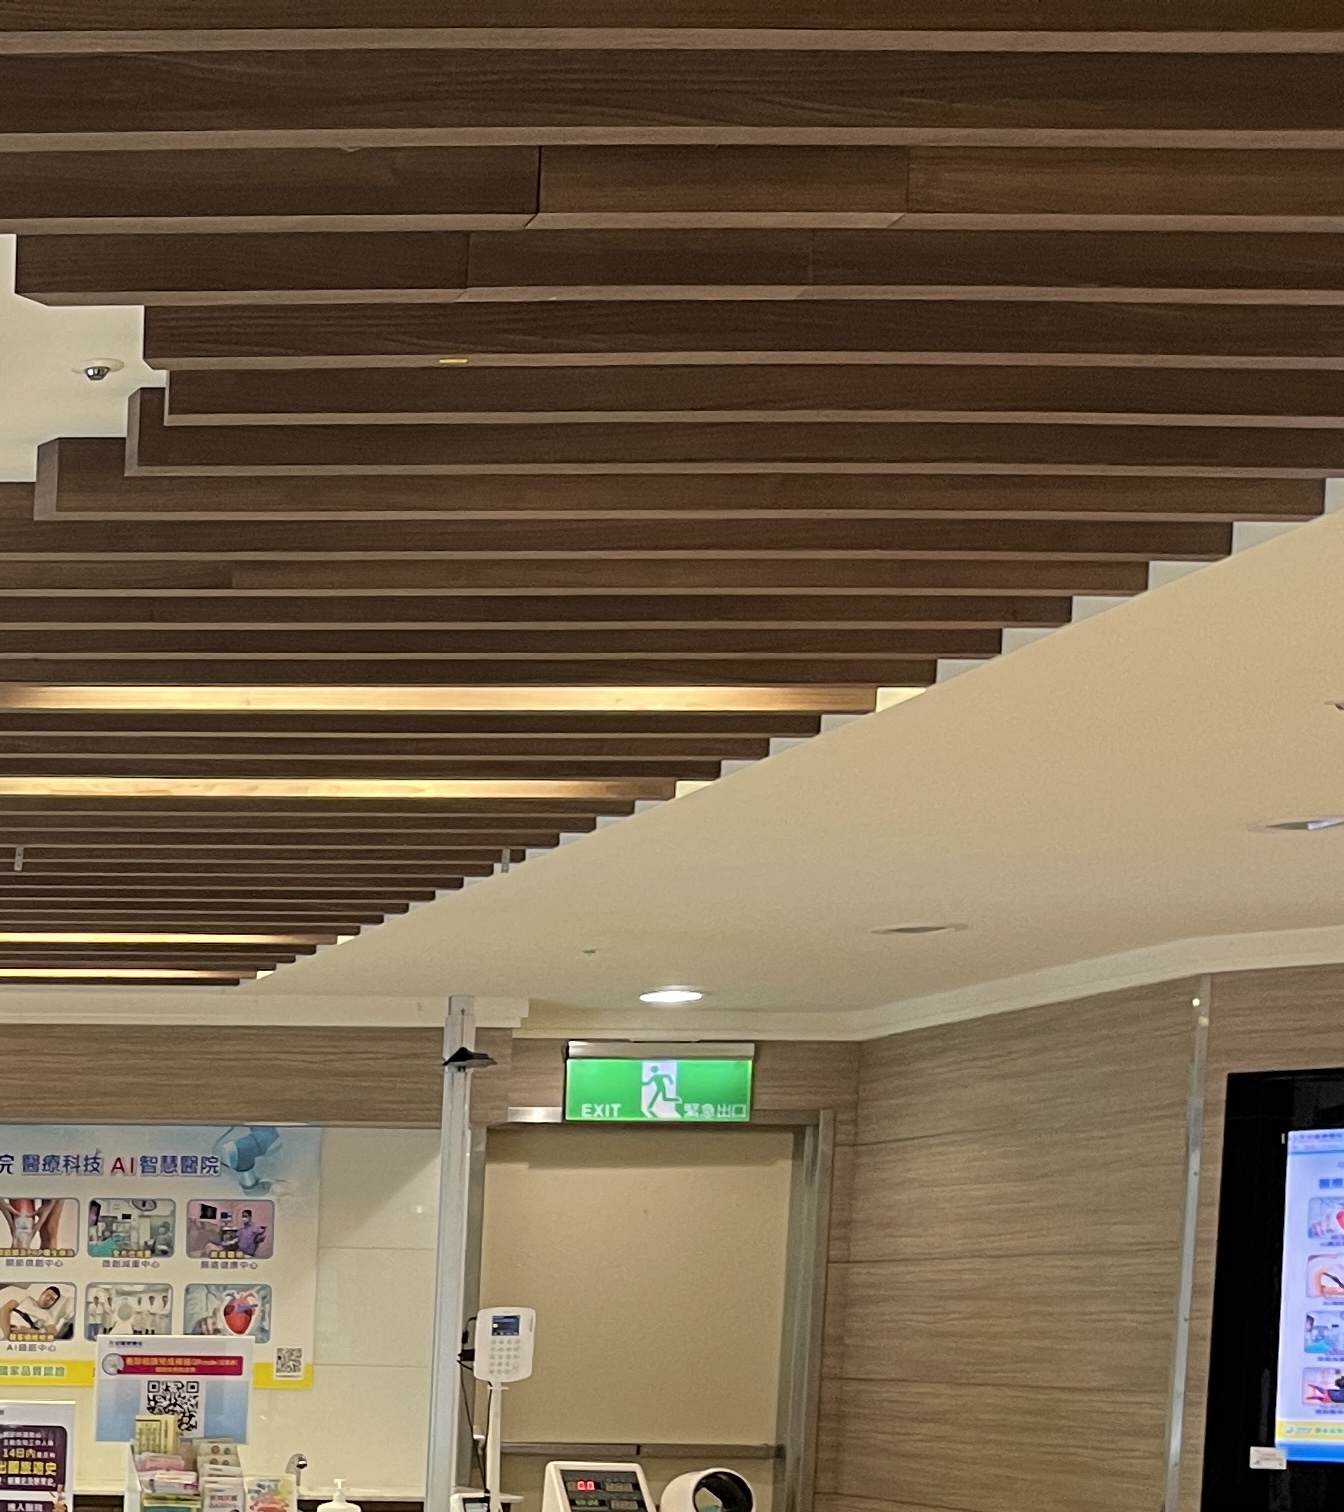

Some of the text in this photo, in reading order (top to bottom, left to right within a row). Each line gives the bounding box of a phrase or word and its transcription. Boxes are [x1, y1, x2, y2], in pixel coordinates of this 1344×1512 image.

[581, 1103, 622, 1118] EXIT
[683, 1102, 747, 1118] 緊急出口
[21, 1153, 103, 1177] 醫療科技
[110, 1154, 222, 1177] AI智慧醫院
